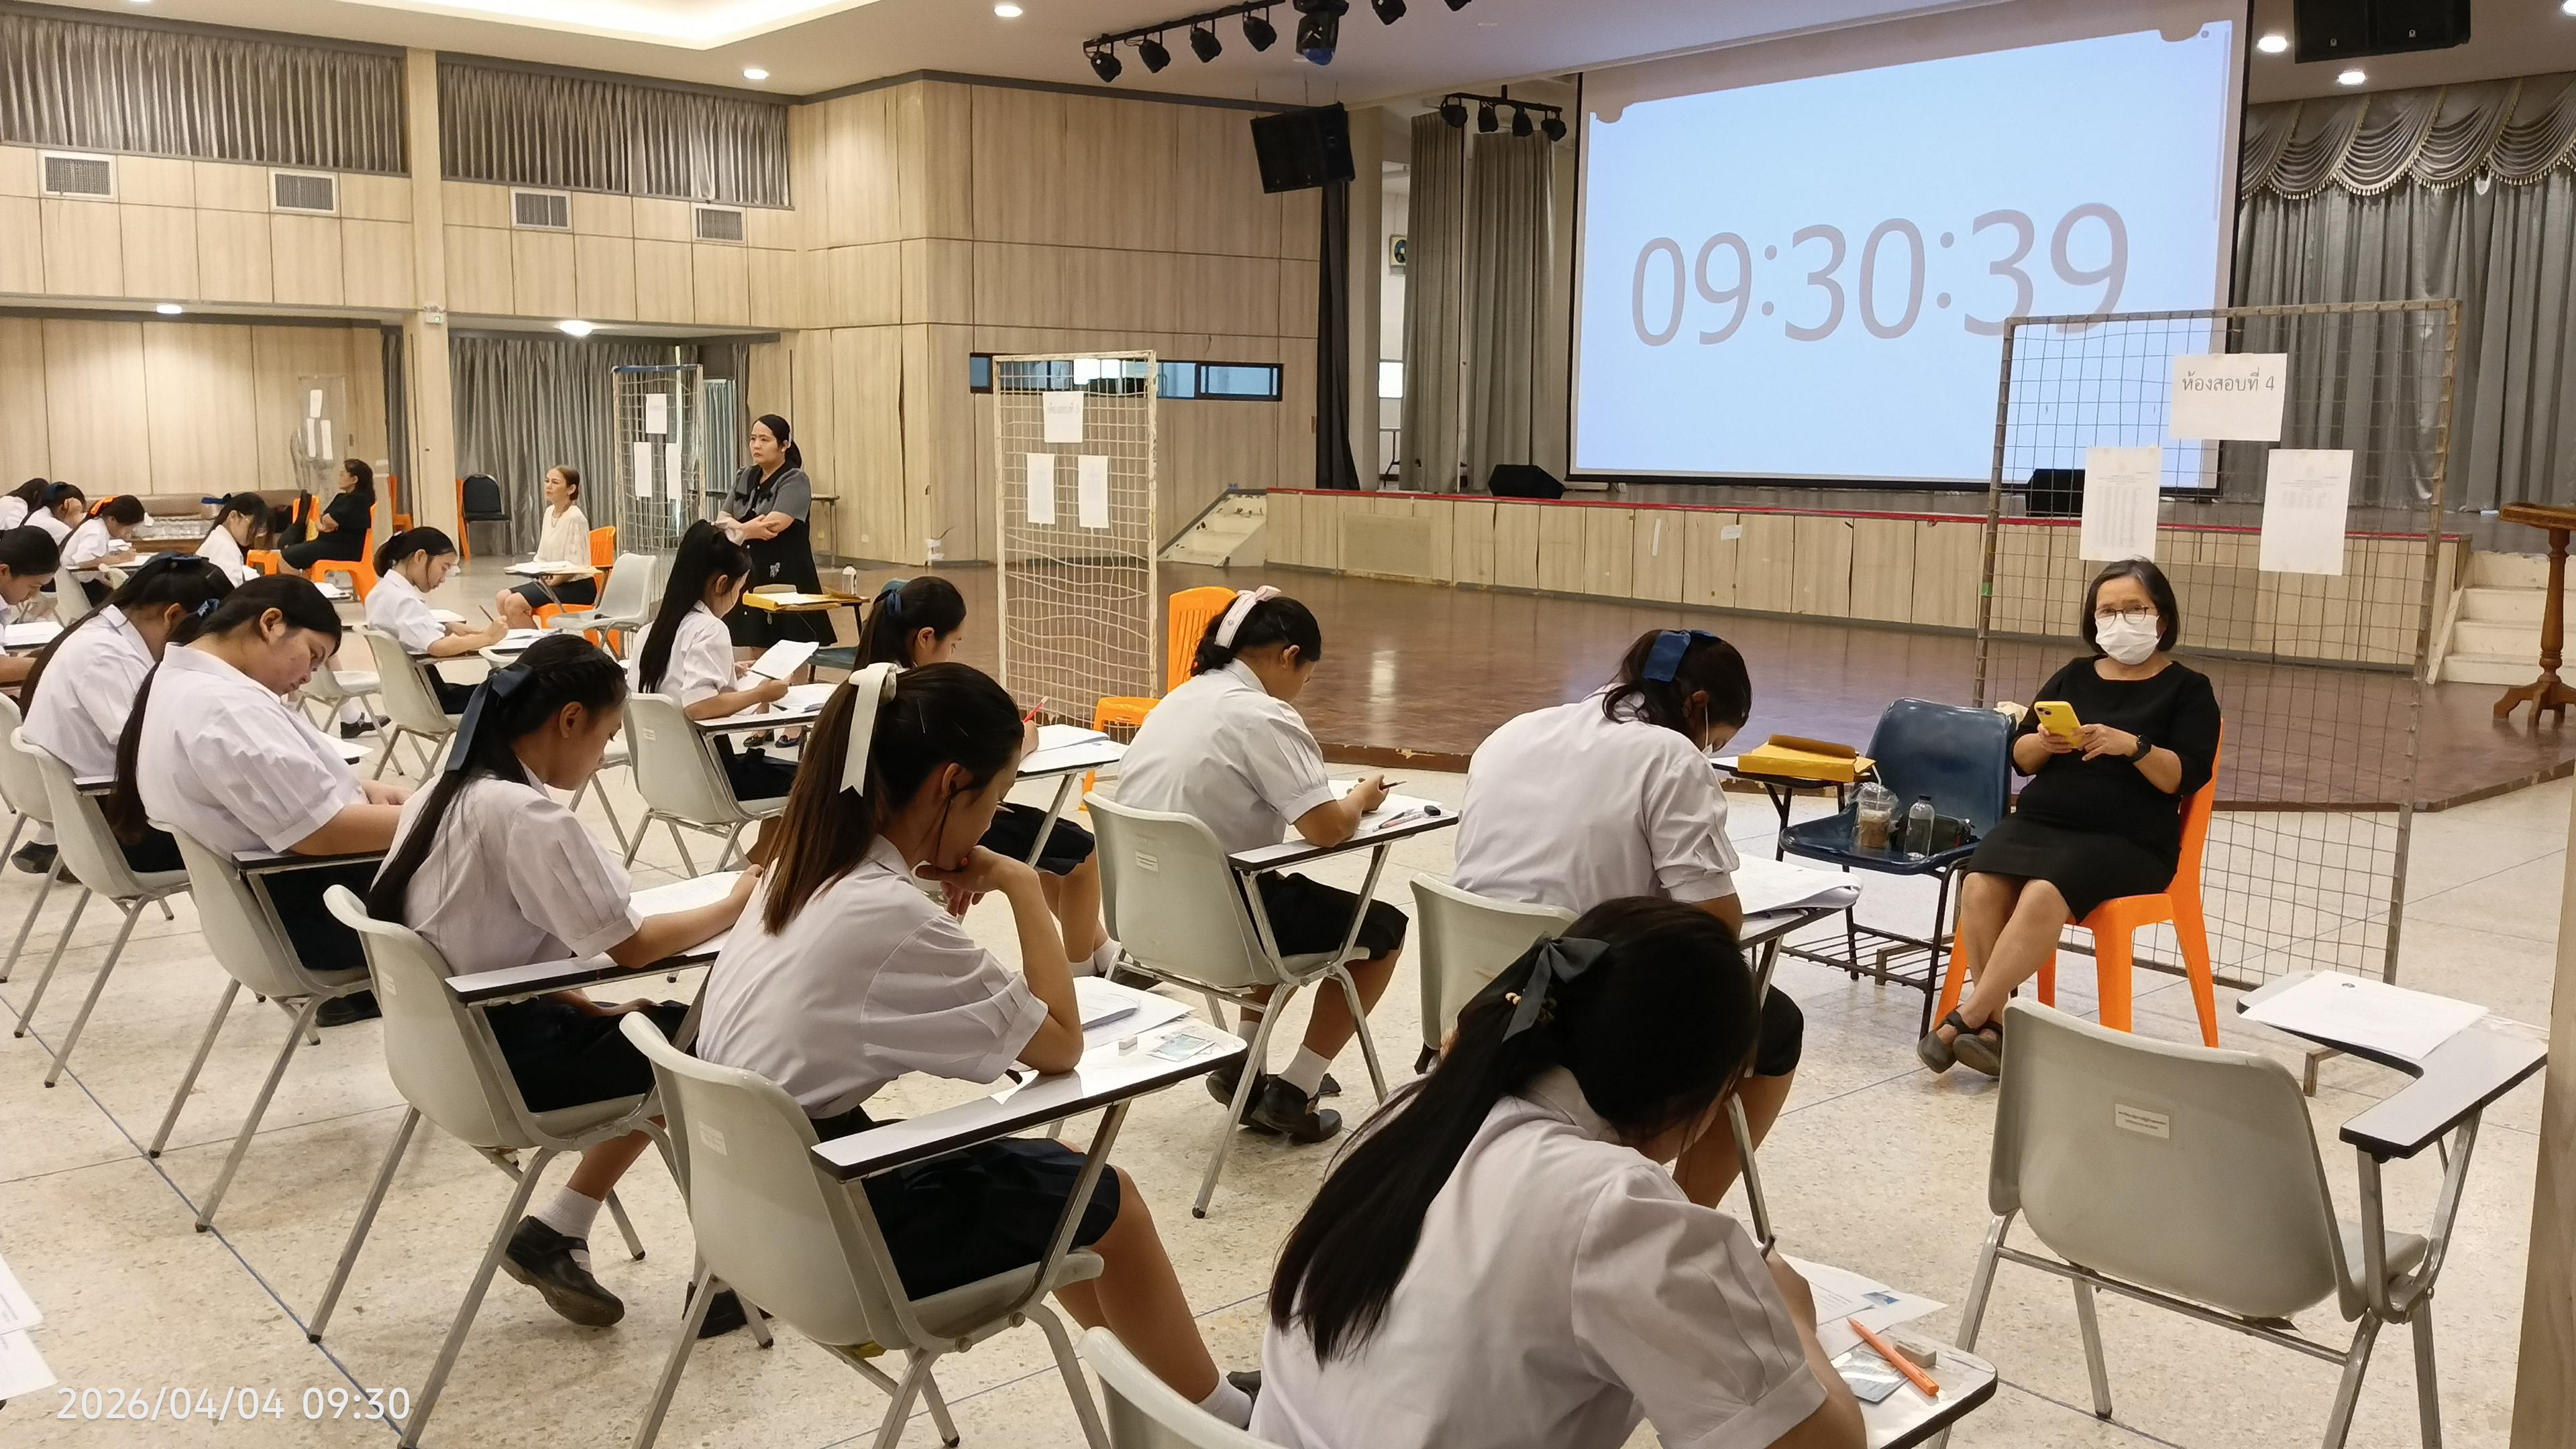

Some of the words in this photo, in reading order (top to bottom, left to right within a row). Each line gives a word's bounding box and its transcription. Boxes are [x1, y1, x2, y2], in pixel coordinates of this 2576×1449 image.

[1631, 202, 2129, 346] 09:30:39
[2182, 366, 2259, 391] ห้องสอบที่
[2265, 376, 2275, 391] 4
